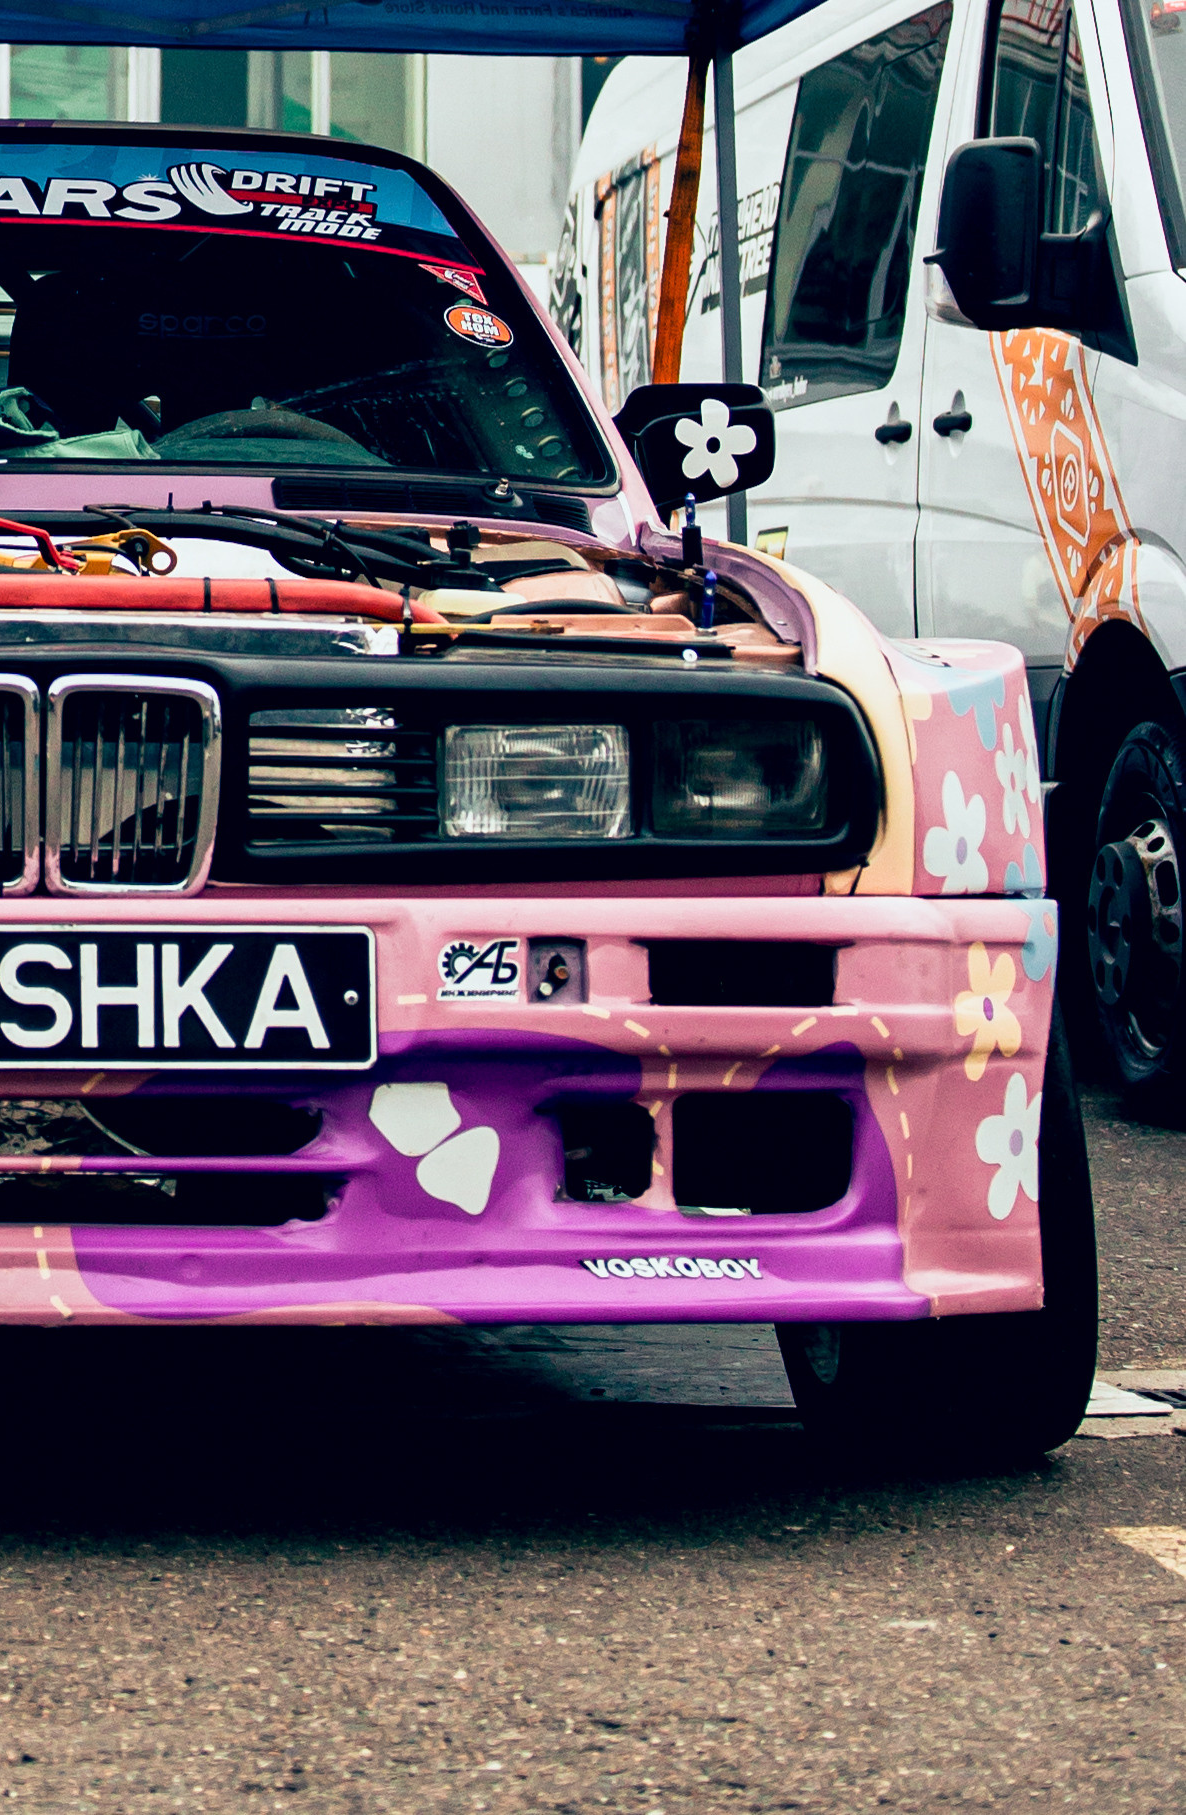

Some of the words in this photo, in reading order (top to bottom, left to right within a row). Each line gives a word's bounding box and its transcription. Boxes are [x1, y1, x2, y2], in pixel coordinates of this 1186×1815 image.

[230, 170, 375, 202] DRIFT
[260, 203, 373, 227] TRACK
[278, 218, 383, 240] MODE
[137, 311, 267, 339] sparco
[581, 1256, 763, 1281] VOSKOBOY
